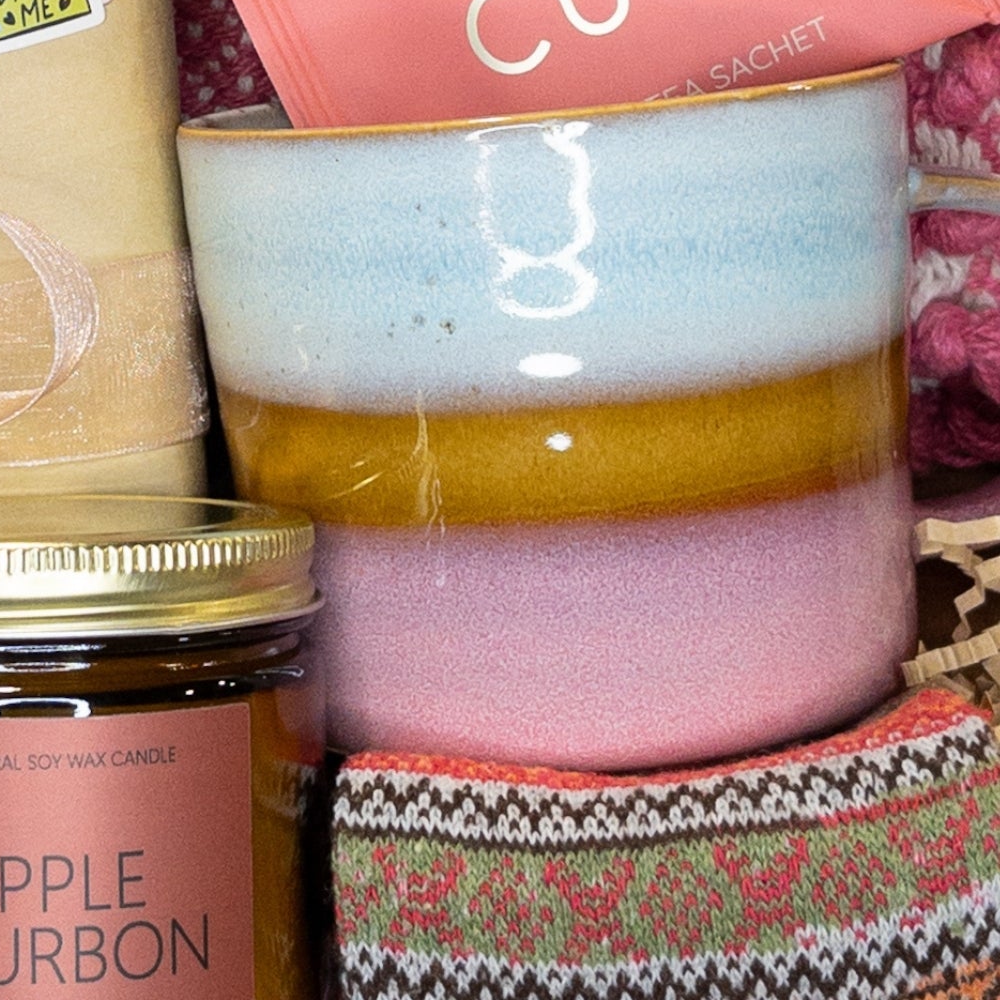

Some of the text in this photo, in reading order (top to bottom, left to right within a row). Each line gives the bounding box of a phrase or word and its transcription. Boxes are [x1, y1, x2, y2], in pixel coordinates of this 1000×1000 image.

[709, 15, 826, 90] SACHET
[27, 753, 63, 770] SOY
[66, 750, 107, 769] WAX
[110, 745, 176, 767] CANDLE
